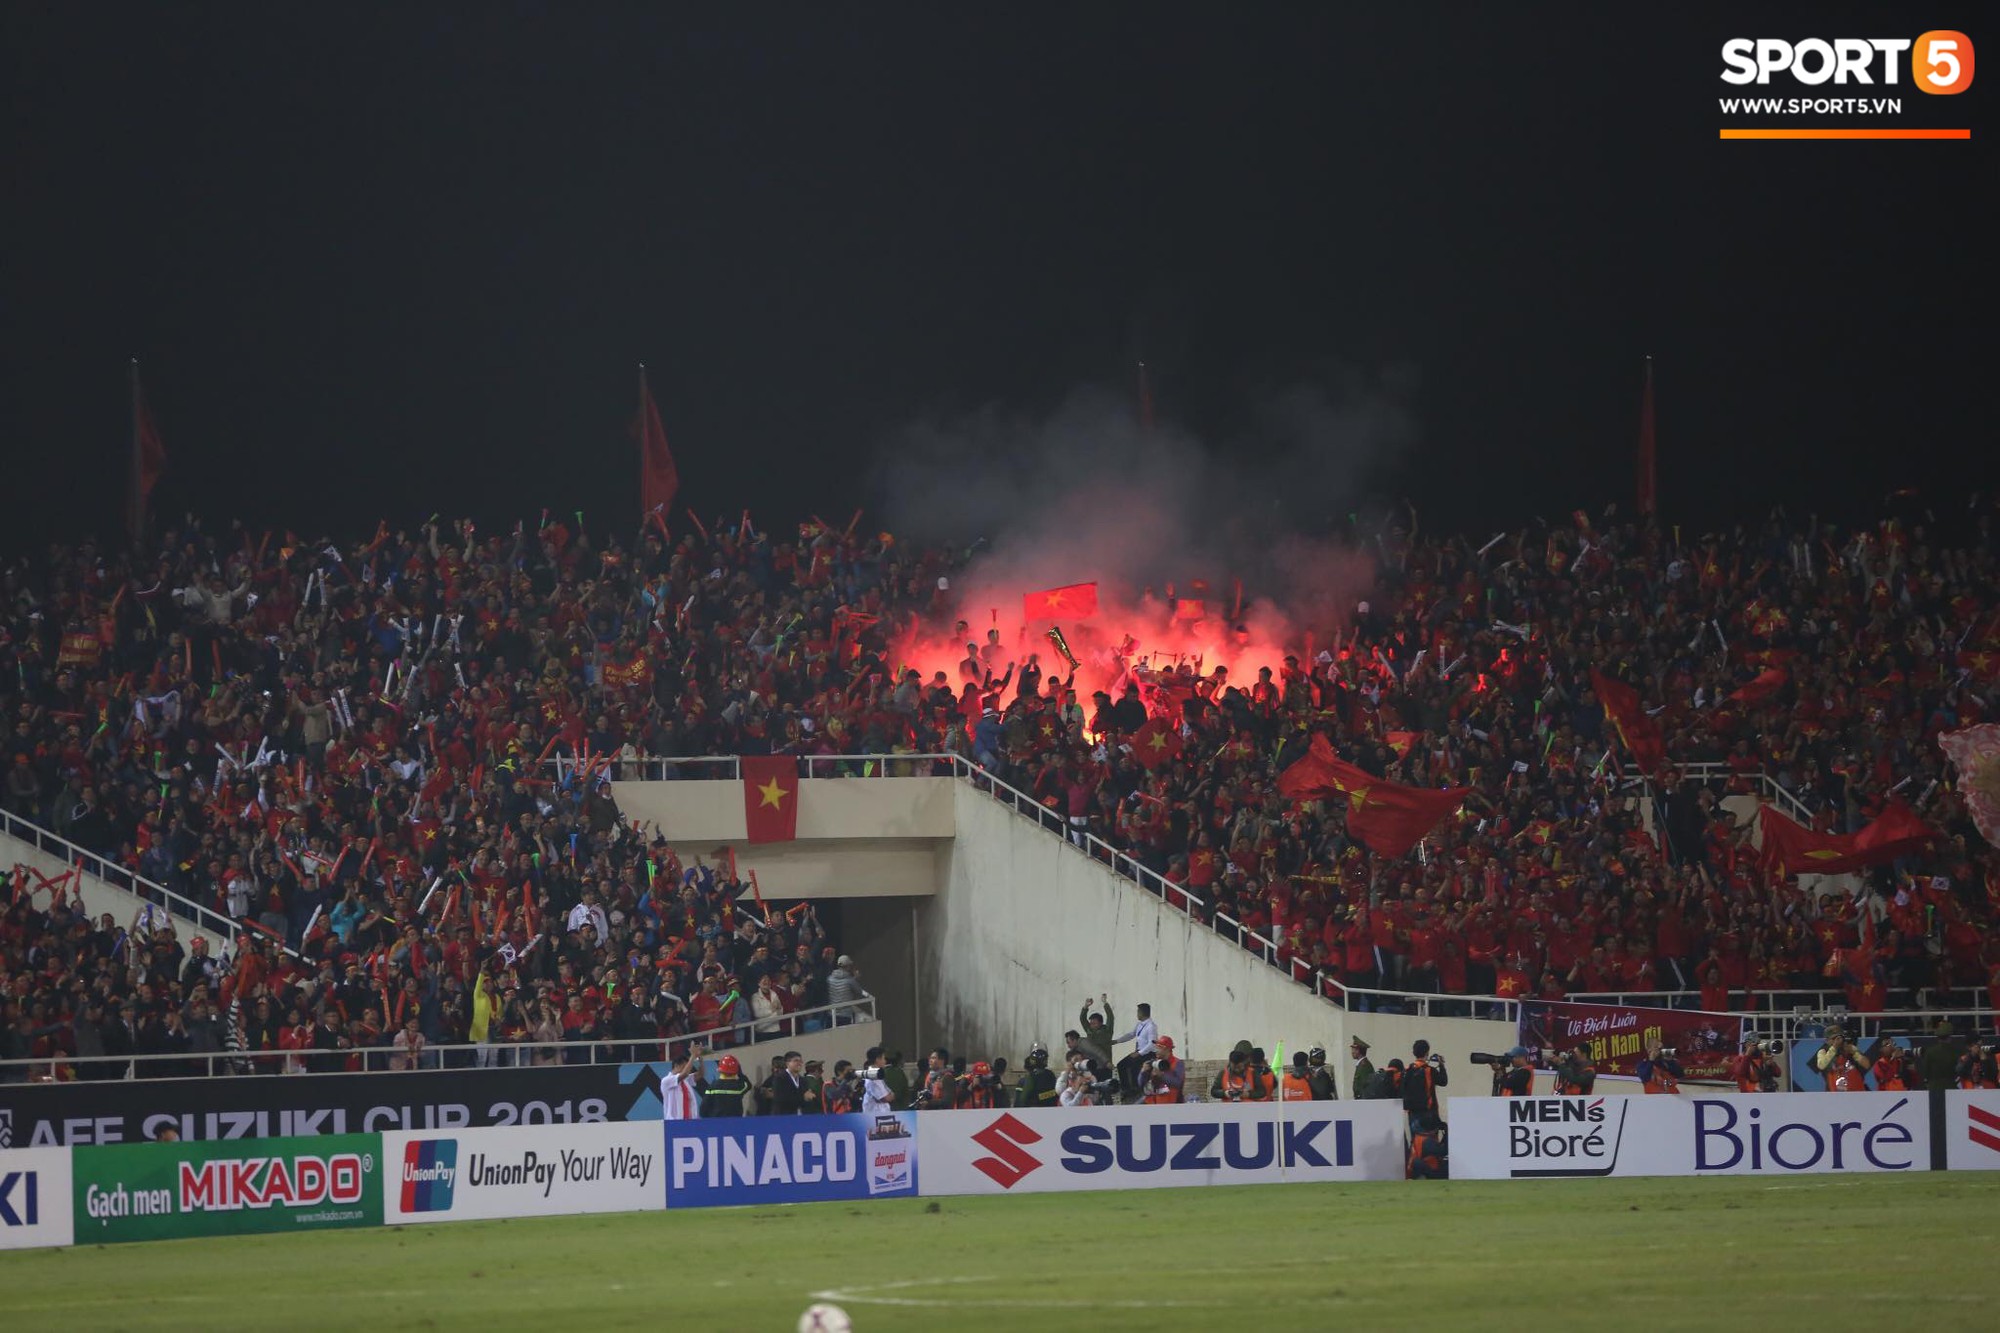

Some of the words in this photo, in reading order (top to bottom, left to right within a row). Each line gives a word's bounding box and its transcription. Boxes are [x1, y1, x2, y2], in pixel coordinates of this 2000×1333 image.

[1611, 1033, 1640, 1058] Nam
[672, 1131, 857, 1190] PINACO
[1060, 1120, 1354, 1174] SUZUKI
[1509, 1125, 1605, 1158] Bioré
[1694, 1098, 1913, 1171] Bioré
[87, 1182, 129, 1227] Gạch
[133, 1188, 171, 1215] men
[179, 1152, 363, 1212] MIKADO
[403, 1161, 455, 1188] UnionPay
[469, 1150, 556, 1198] UnionPay
[560, 1149, 604, 1182] Your
[610, 1147, 652, 1188] Way
